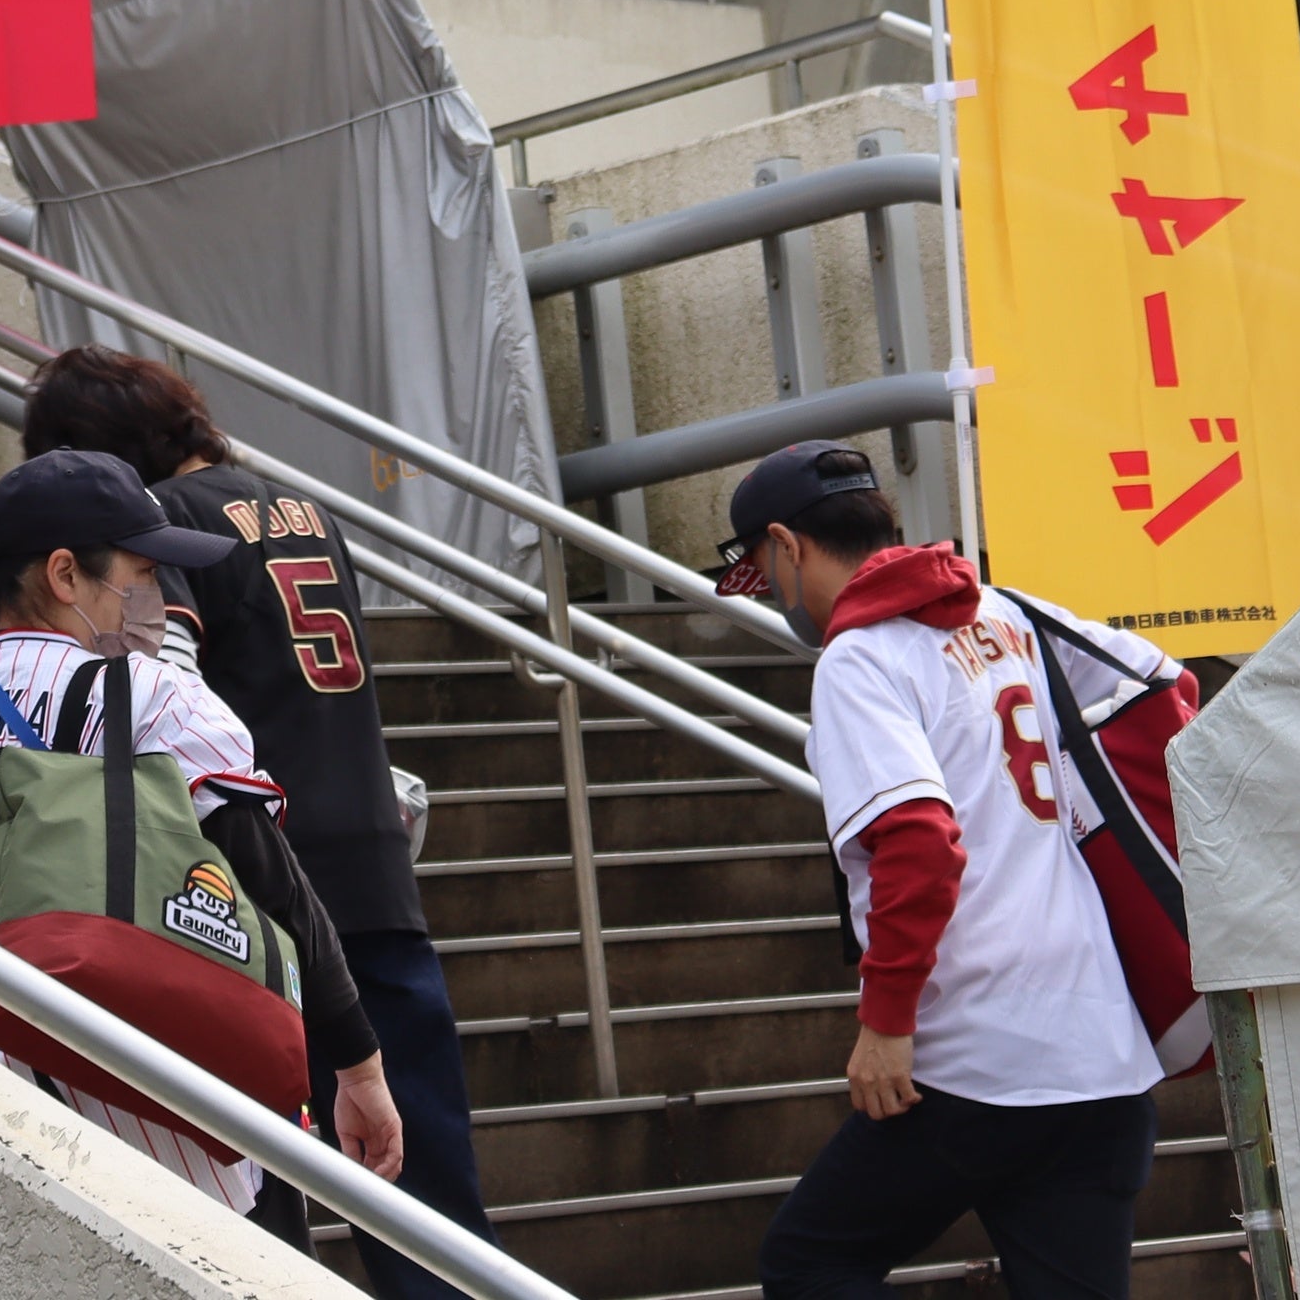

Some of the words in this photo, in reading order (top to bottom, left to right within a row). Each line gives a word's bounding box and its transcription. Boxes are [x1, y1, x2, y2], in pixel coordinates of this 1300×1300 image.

[265, 556, 366, 693] 5
[1107, 605, 1277, 632] 福島日産自動車株式会社
[994, 682, 1061, 824] 8
[174, 908, 241, 952] Laundry
